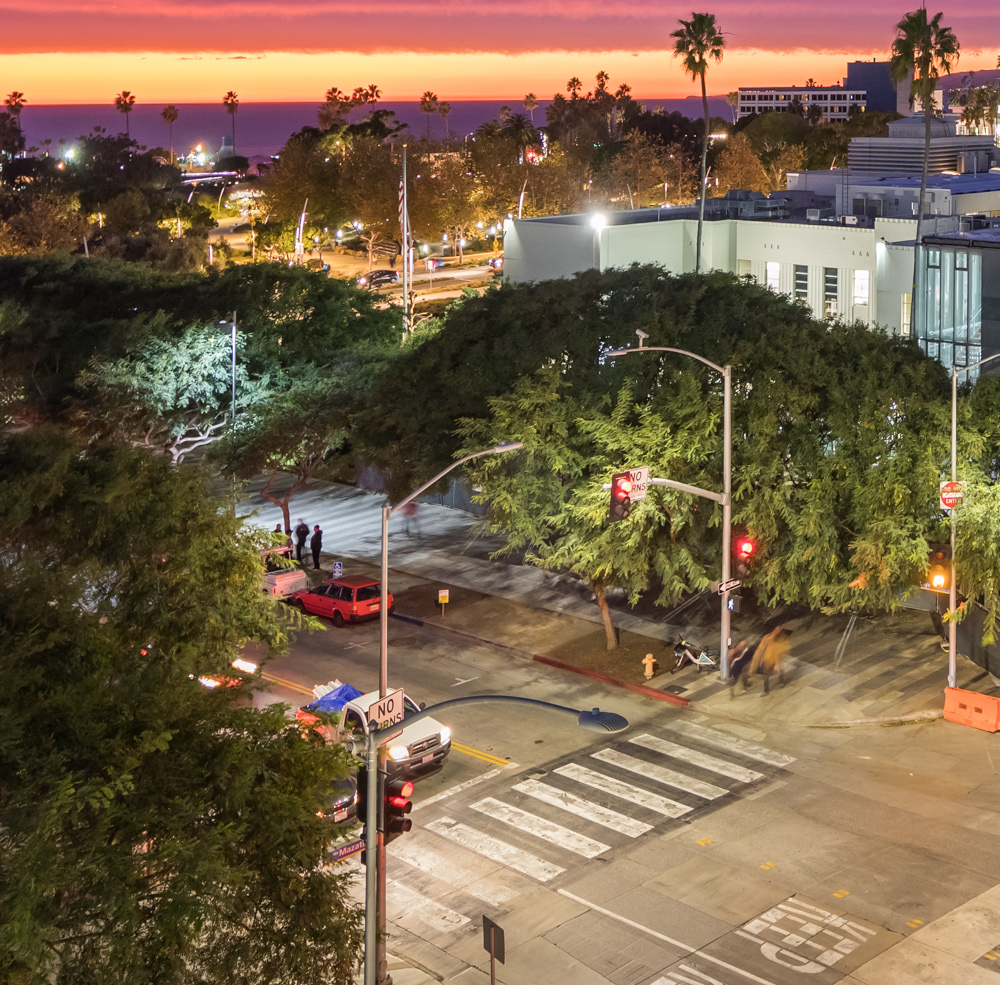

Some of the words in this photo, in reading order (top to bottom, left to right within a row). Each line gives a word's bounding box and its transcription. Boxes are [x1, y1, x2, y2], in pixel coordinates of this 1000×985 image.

[630, 472, 642, 482] NO
[632, 483, 646, 492] RNS
[378, 698, 394, 719] NO
